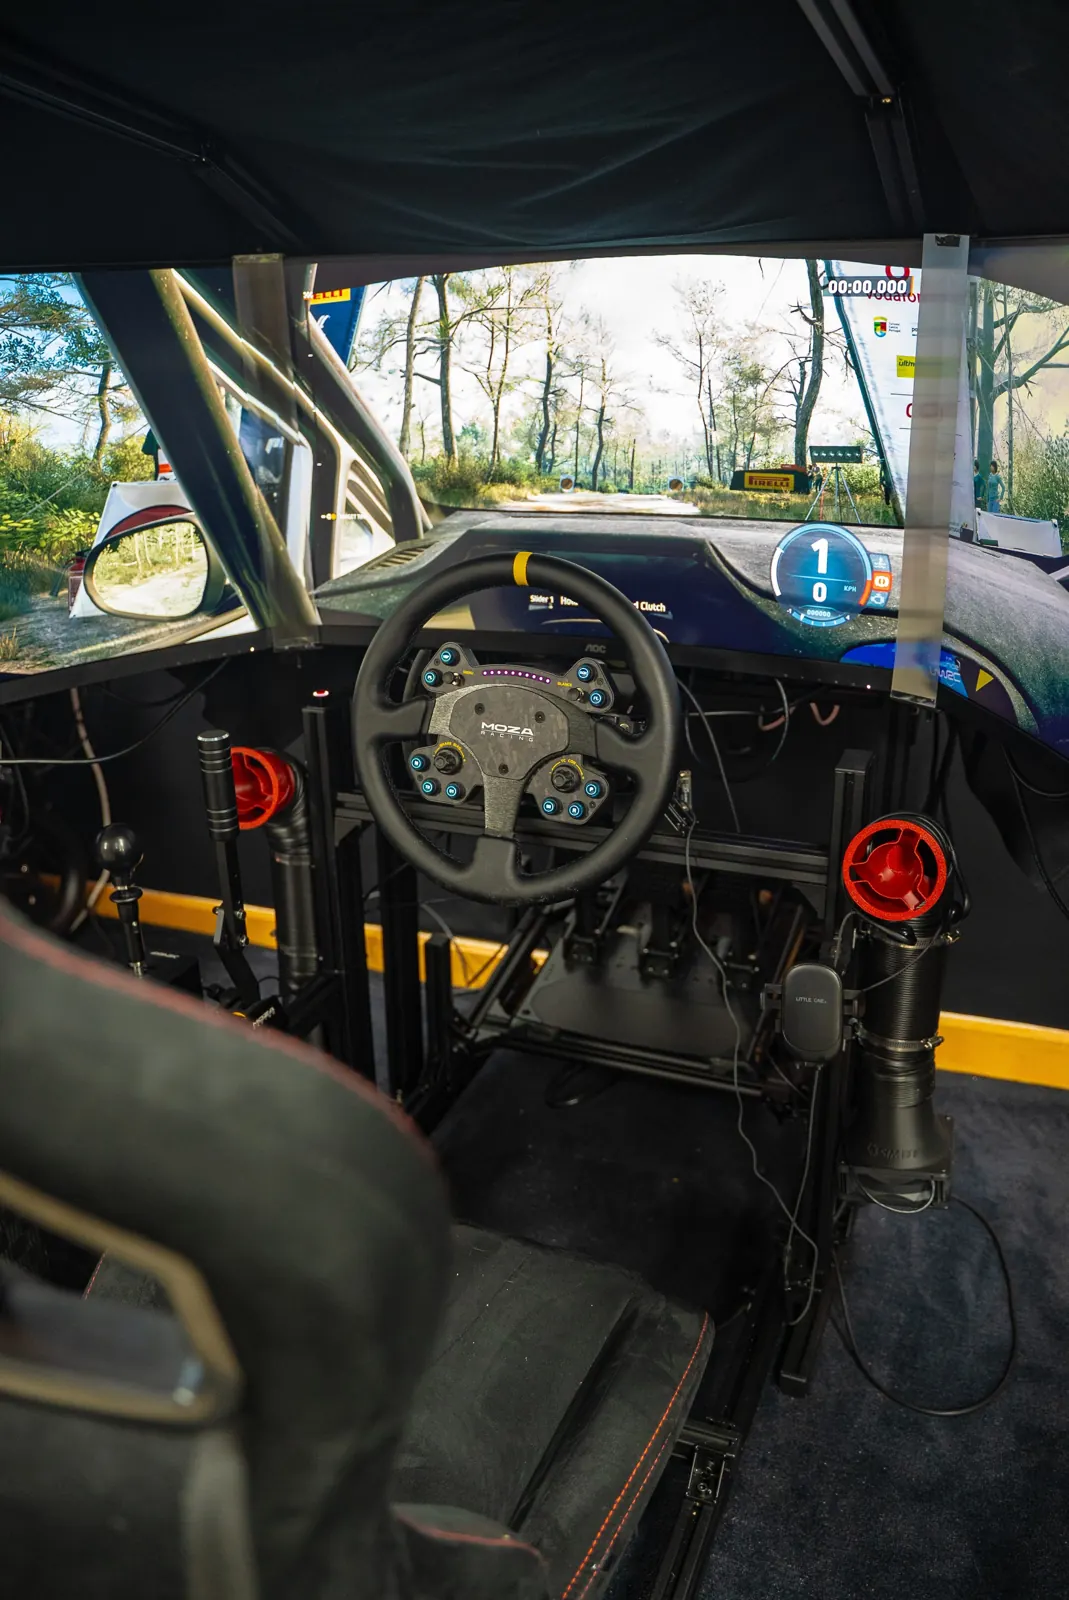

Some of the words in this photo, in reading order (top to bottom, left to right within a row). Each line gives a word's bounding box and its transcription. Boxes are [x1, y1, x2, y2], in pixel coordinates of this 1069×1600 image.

[828, 279, 908, 294] 00:00.000
[312, 289, 343, 300] ELLI
[748, 475, 790, 488] PIRELLI
[810, 538, 829, 575] 1
[530, 594, 549, 603] Slider
[549, 595, 555, 604] 1
[812, 582, 828, 603] 0
[843, 585, 857, 593] KPH
[640, 601, 667, 612] Clutch
[585, 643, 607, 654] AOC
[481, 721, 534, 736] MOZA
[480, 730, 534, 743] RACING
